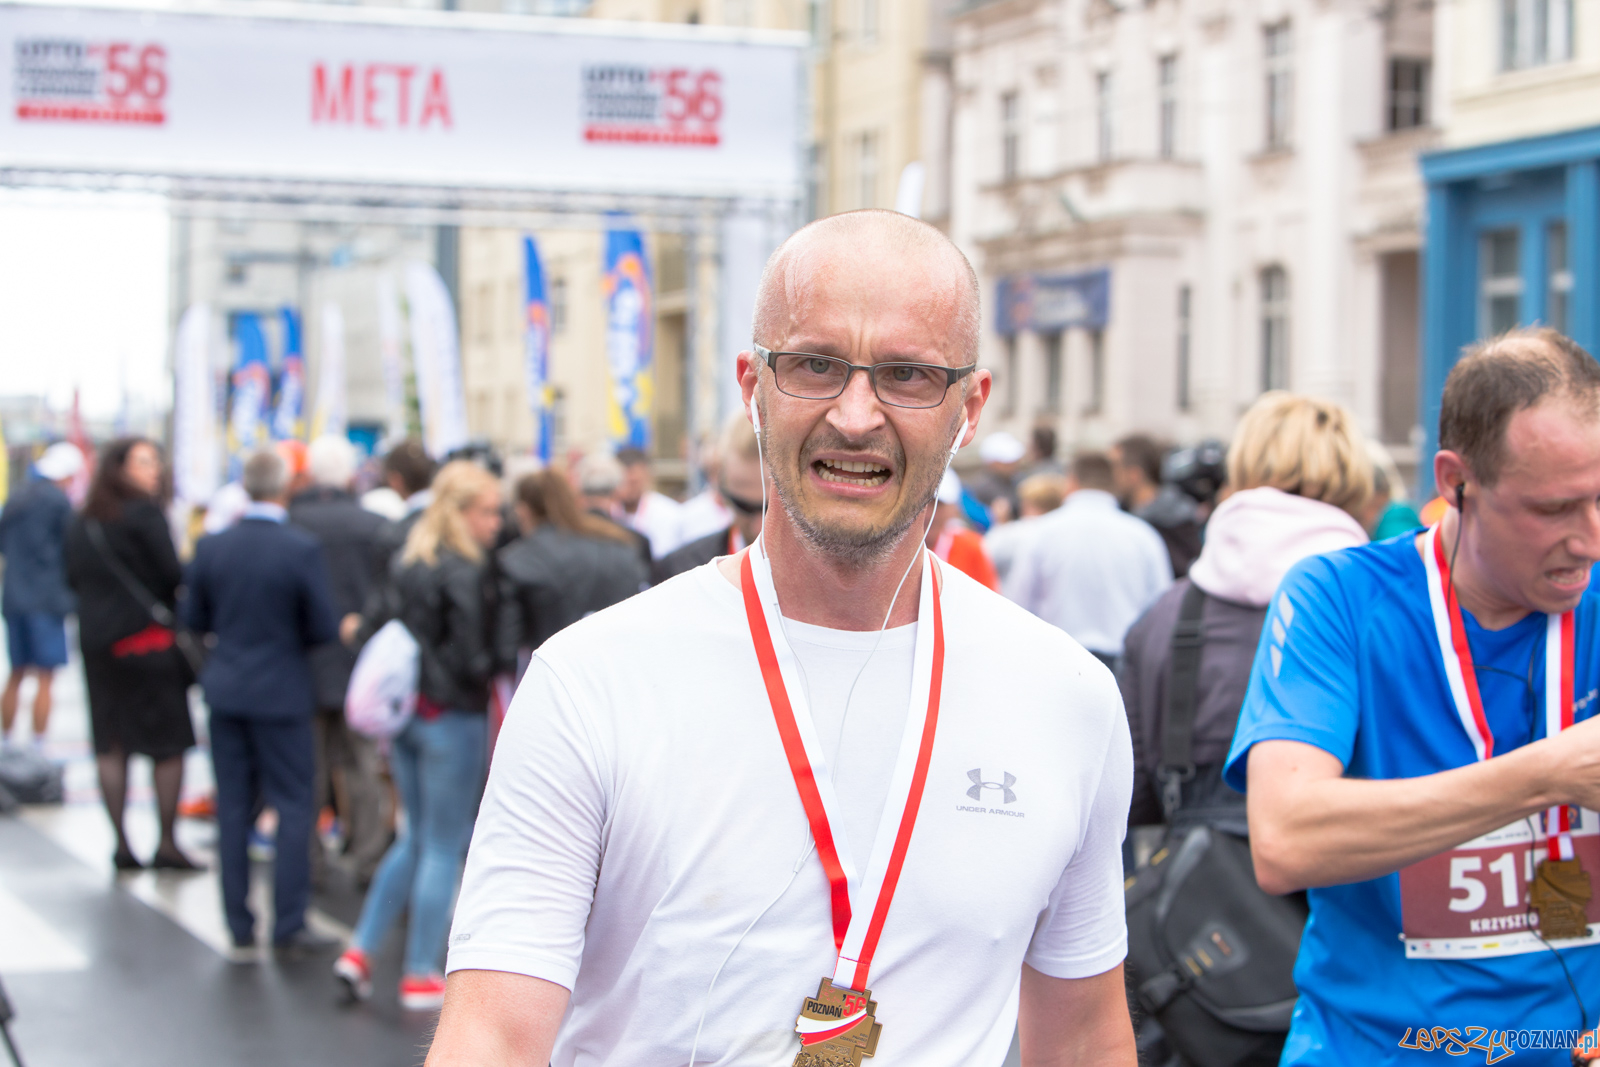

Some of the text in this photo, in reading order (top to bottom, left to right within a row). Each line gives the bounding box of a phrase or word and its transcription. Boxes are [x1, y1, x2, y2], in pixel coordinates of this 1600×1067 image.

[310, 62, 453, 130] META
[956, 805, 1025, 818] UNDER ARMOUR
[1470, 912, 1540, 933] KRZYSZTO
[806, 1000, 842, 1018] POZNAŃ
